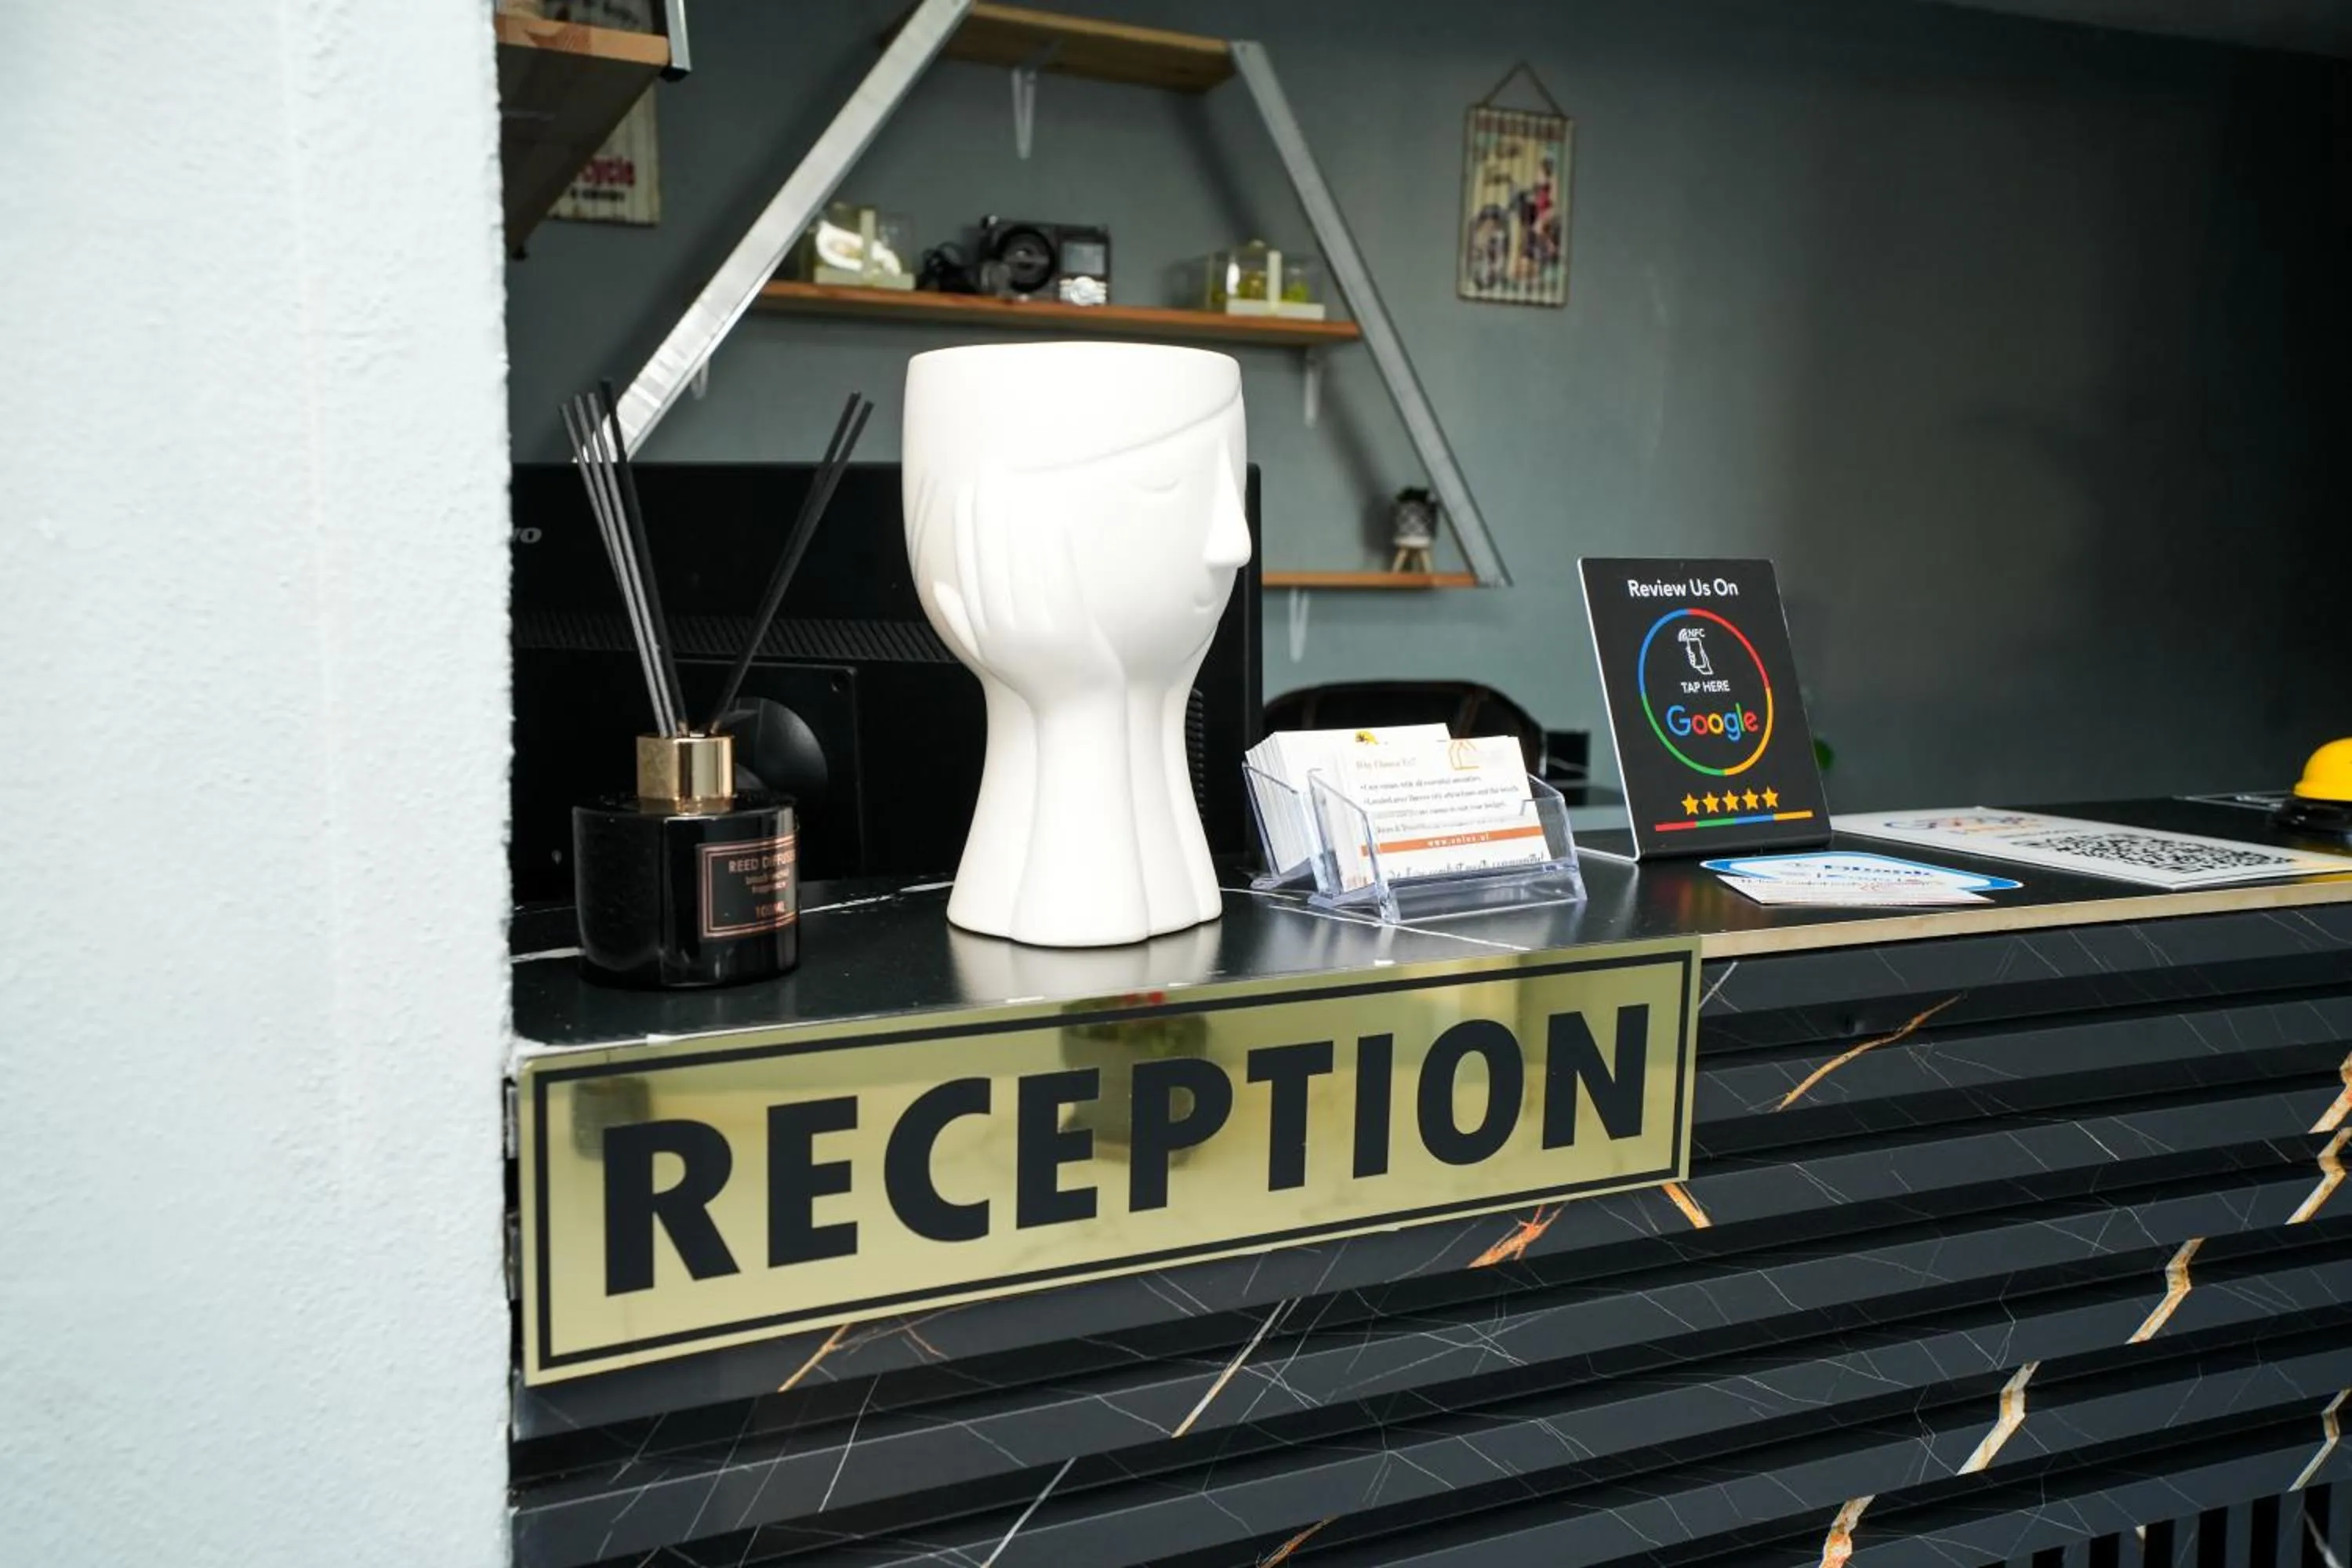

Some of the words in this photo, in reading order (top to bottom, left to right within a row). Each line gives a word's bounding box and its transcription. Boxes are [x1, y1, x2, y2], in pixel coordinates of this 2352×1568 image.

[1628, 579, 1686, 597] Review
[1690, 579, 1710, 596] Us
[1714, 578, 1739, 596] On
[1681, 681, 1700, 693] TAP
[1703, 681, 1730, 692] HERE
[1666, 702, 1759, 742] Google
[728, 858, 759, 873] REED
[604, 1004, 1650, 1296] RECEPTION
